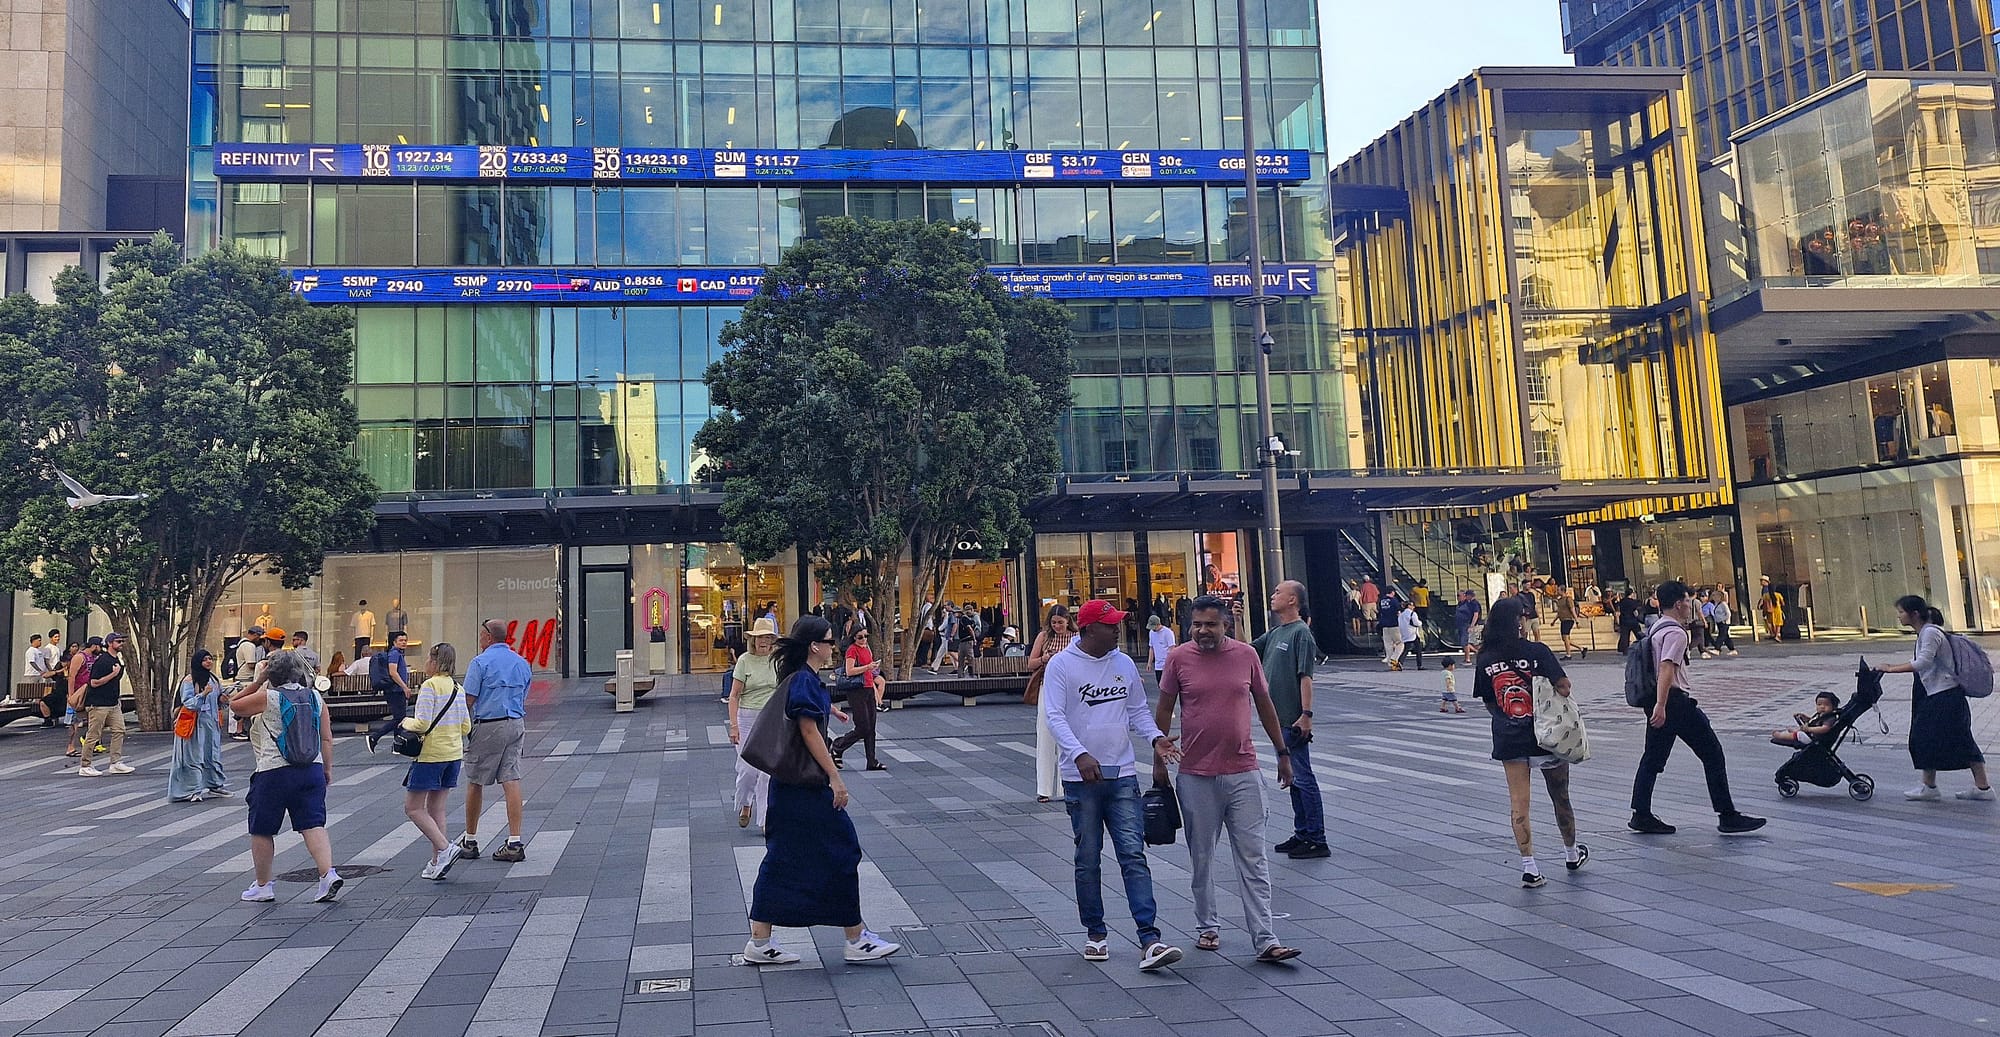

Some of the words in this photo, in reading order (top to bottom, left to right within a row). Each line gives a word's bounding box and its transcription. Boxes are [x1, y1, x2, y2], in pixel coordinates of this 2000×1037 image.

[221, 152, 301, 166] REFINITIV
[364, 150, 389, 169] 10
[396, 151, 454, 163] 1927.34
[479, 152, 507, 170] 20
[511, 152, 568, 164] 7633.43
[593, 154, 621, 171] 50
[625, 154, 688, 165] 13423.18
[714, 151, 746, 163] SUM
[754, 154, 800, 167] $11.57
[1025, 153, 1053, 164] GBF
[1061, 155, 1097, 167] $3.17
[1122, 153, 1150, 164] GEN
[1255, 155, 1289, 167] $2.51
[1219, 158, 1246, 169] GGB
[362, 168, 391, 177] INDEX
[479, 169, 508, 178] INDEX
[593, 170, 621, 179] INDEX
[342, 276, 378, 287] SSMP
[453, 276, 488, 287] SSMP
[624, 276, 663, 286] 0.8636
[730, 276, 765, 286] 0.817
[1010, 271, 1040, 282] fastest
[1042, 271, 1074, 284] growth
[1076, 271, 1087, 281] of
[1088, 273, 1105, 284] any
[1106, 271, 1136, 284] region
[1137, 273, 1148, 281] as
[1213, 274, 1281, 287] REFINTIV
[386, 280, 424, 292] 2940
[496, 280, 532, 291] 2970
[593, 281, 620, 291] AUD
[700, 280, 726, 290] CAD
[349, 289, 372, 298] MAR
[461, 288, 481, 297] APR
